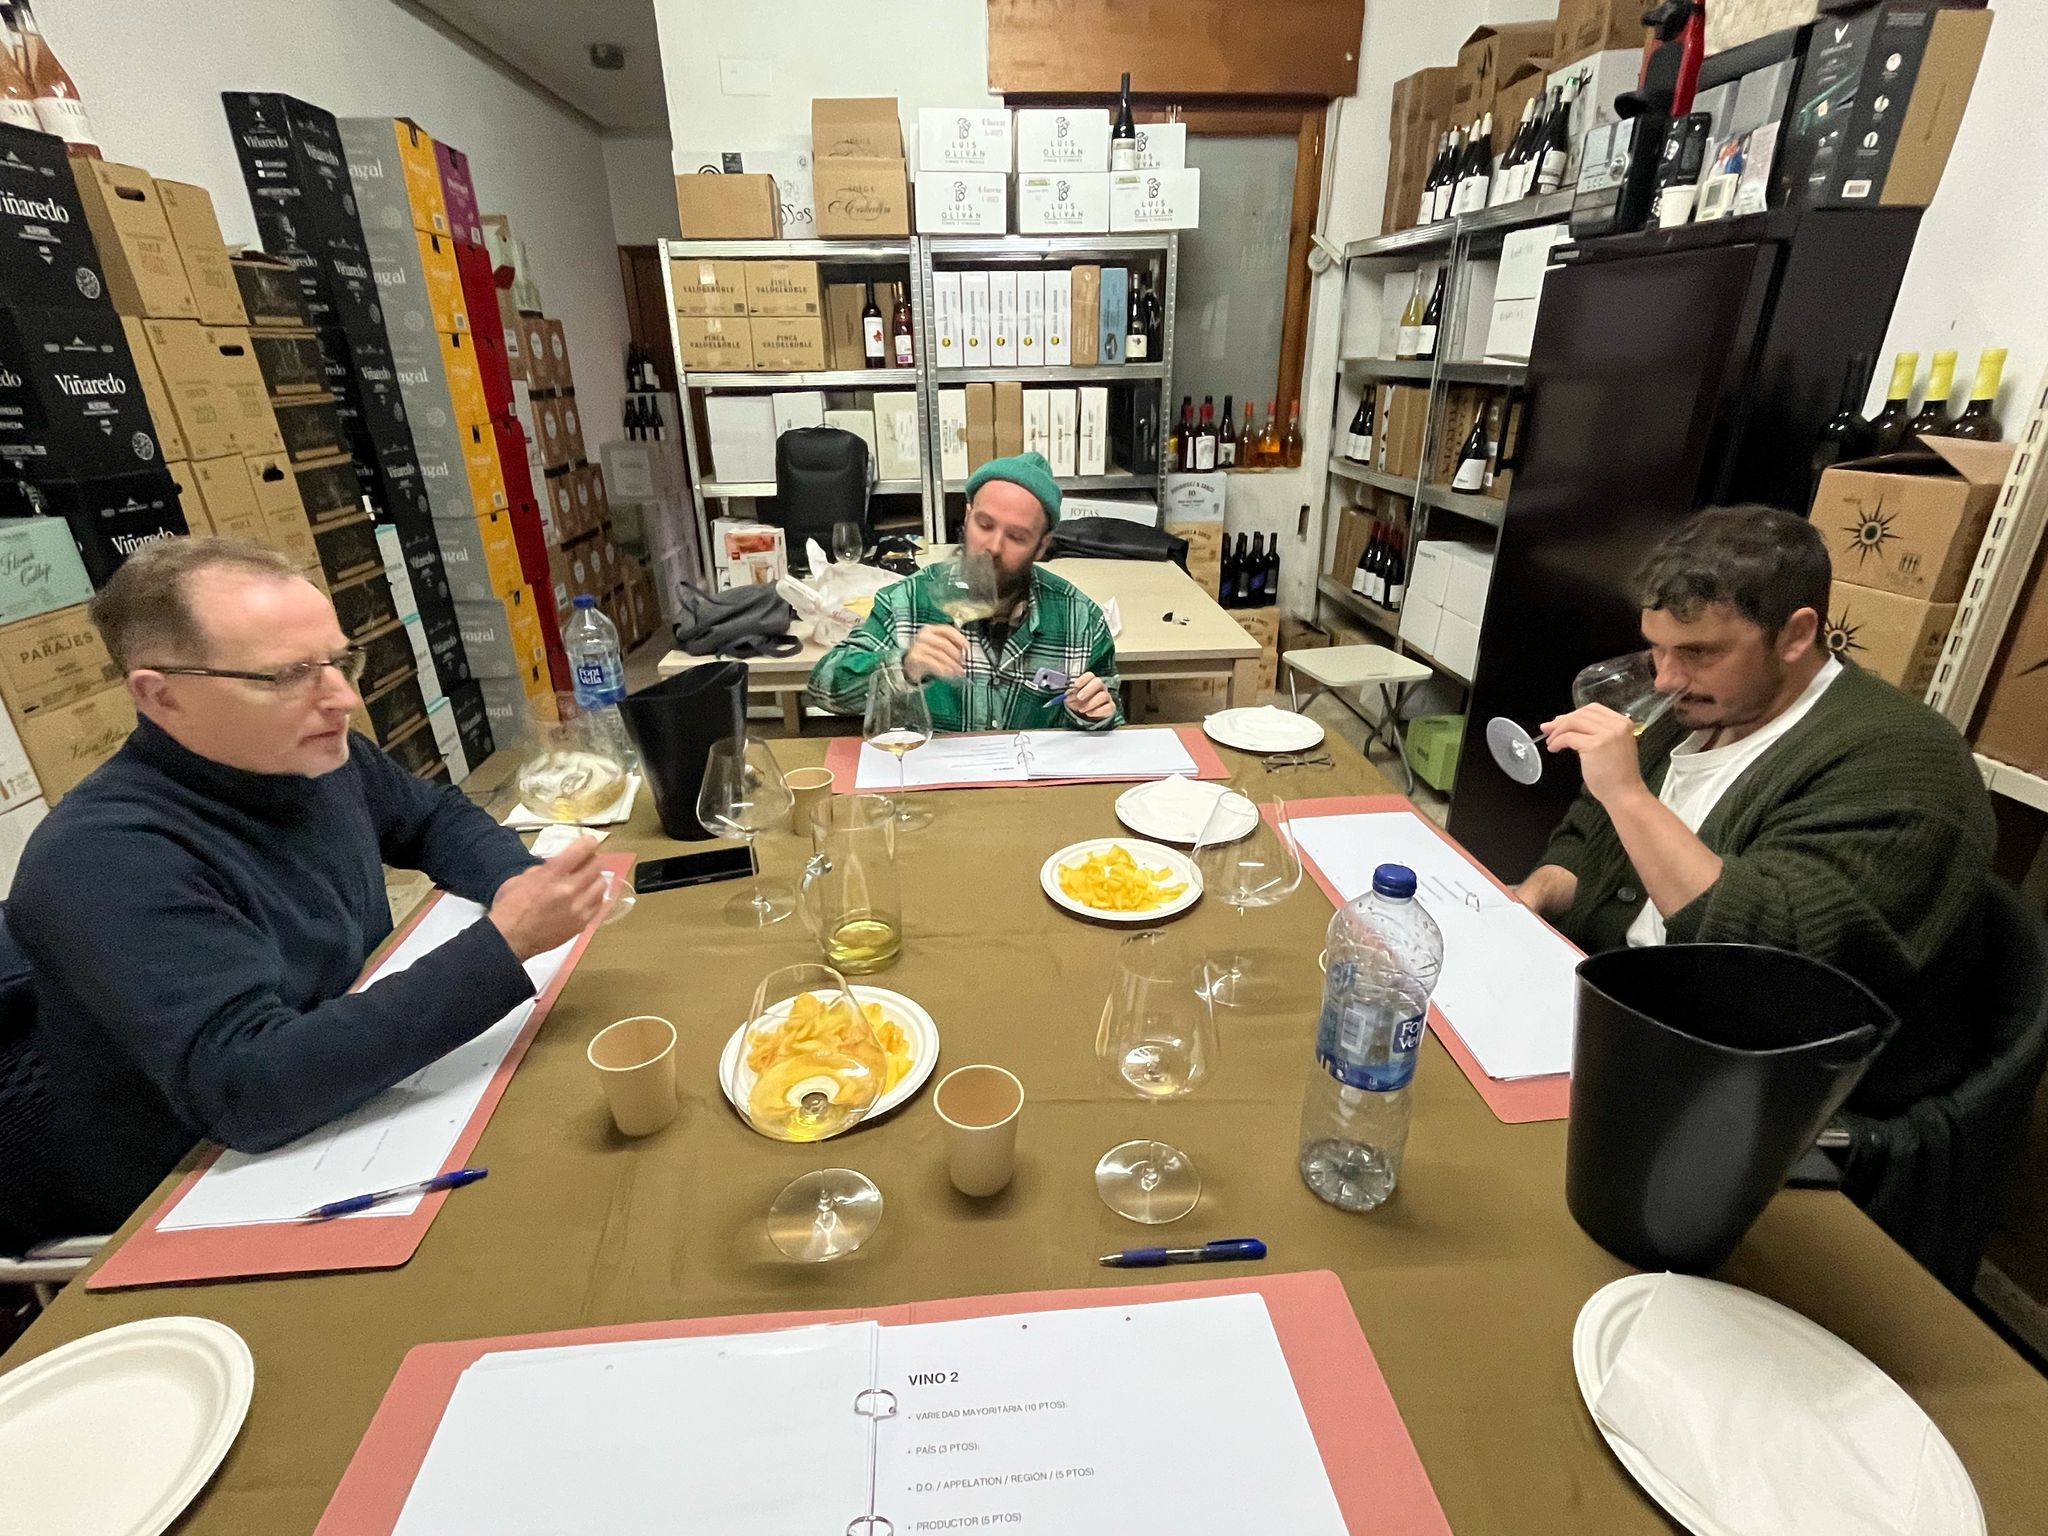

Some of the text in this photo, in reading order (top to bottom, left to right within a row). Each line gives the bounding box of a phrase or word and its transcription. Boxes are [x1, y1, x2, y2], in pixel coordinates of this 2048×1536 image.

[952, 141, 977, 149] LUIS
[1050, 140, 1075, 148] LUIS
[0, 190, 70, 224] iñaredo
[1051, 202, 1076, 210] LUIS
[1141, 200, 1166, 208] LUIS
[325, 363, 346, 376] redo
[54, 371, 127, 396] Viñaredo
[19, 631, 95, 664] PARAJES
[908, 1371, 960, 1386] VINO 2
[915, 1409, 961, 1421] VARIEDAD
[962, 1404, 1023, 1417] MAYORITARIA
[1024, 1402, 1037, 1413] (10
[915, 1442, 937, 1455] PAÍS
[938, 1444, 948, 1454] (3
[915, 1482, 935, 1493] D.O.
[943, 1475, 1003, 1491] APPELATION
[1010, 1470, 1048, 1483] REGIÓN
[1055, 1469, 1065, 1480] (5
[1066, 1467, 1095, 1479] PTOS)
[916, 1511, 1022, 1532] PRODUCTOR (5 PTOS)
